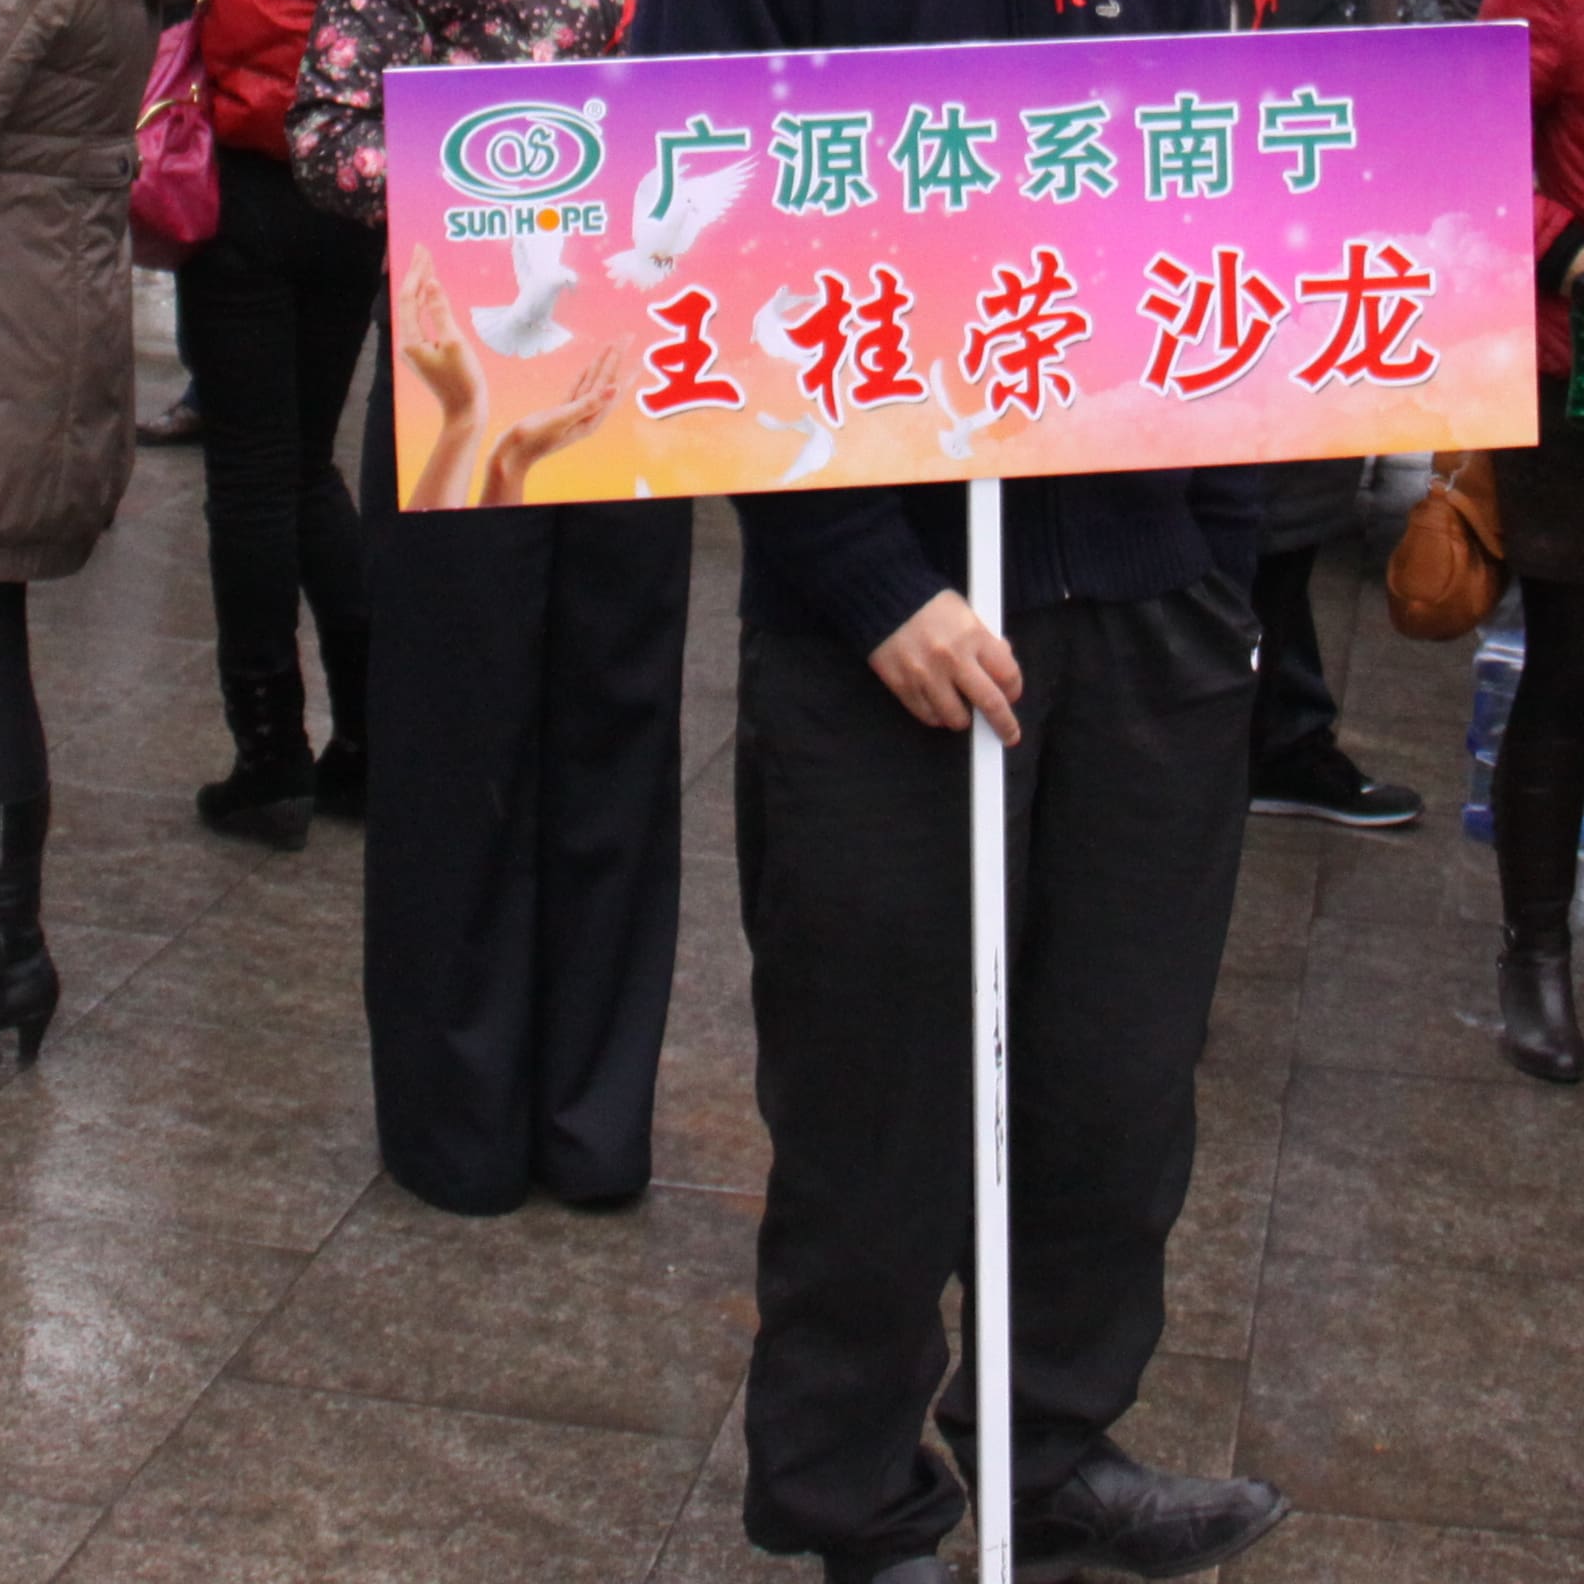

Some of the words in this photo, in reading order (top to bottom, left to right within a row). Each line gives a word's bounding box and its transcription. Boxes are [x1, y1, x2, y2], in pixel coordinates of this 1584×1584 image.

[649, 90, 1356, 220] 广源体系南宁
[447, 208, 507, 238] SUN
[514, 204, 605, 234] HOPE
[640, 243, 1438, 421] 王桂荣沙龙
